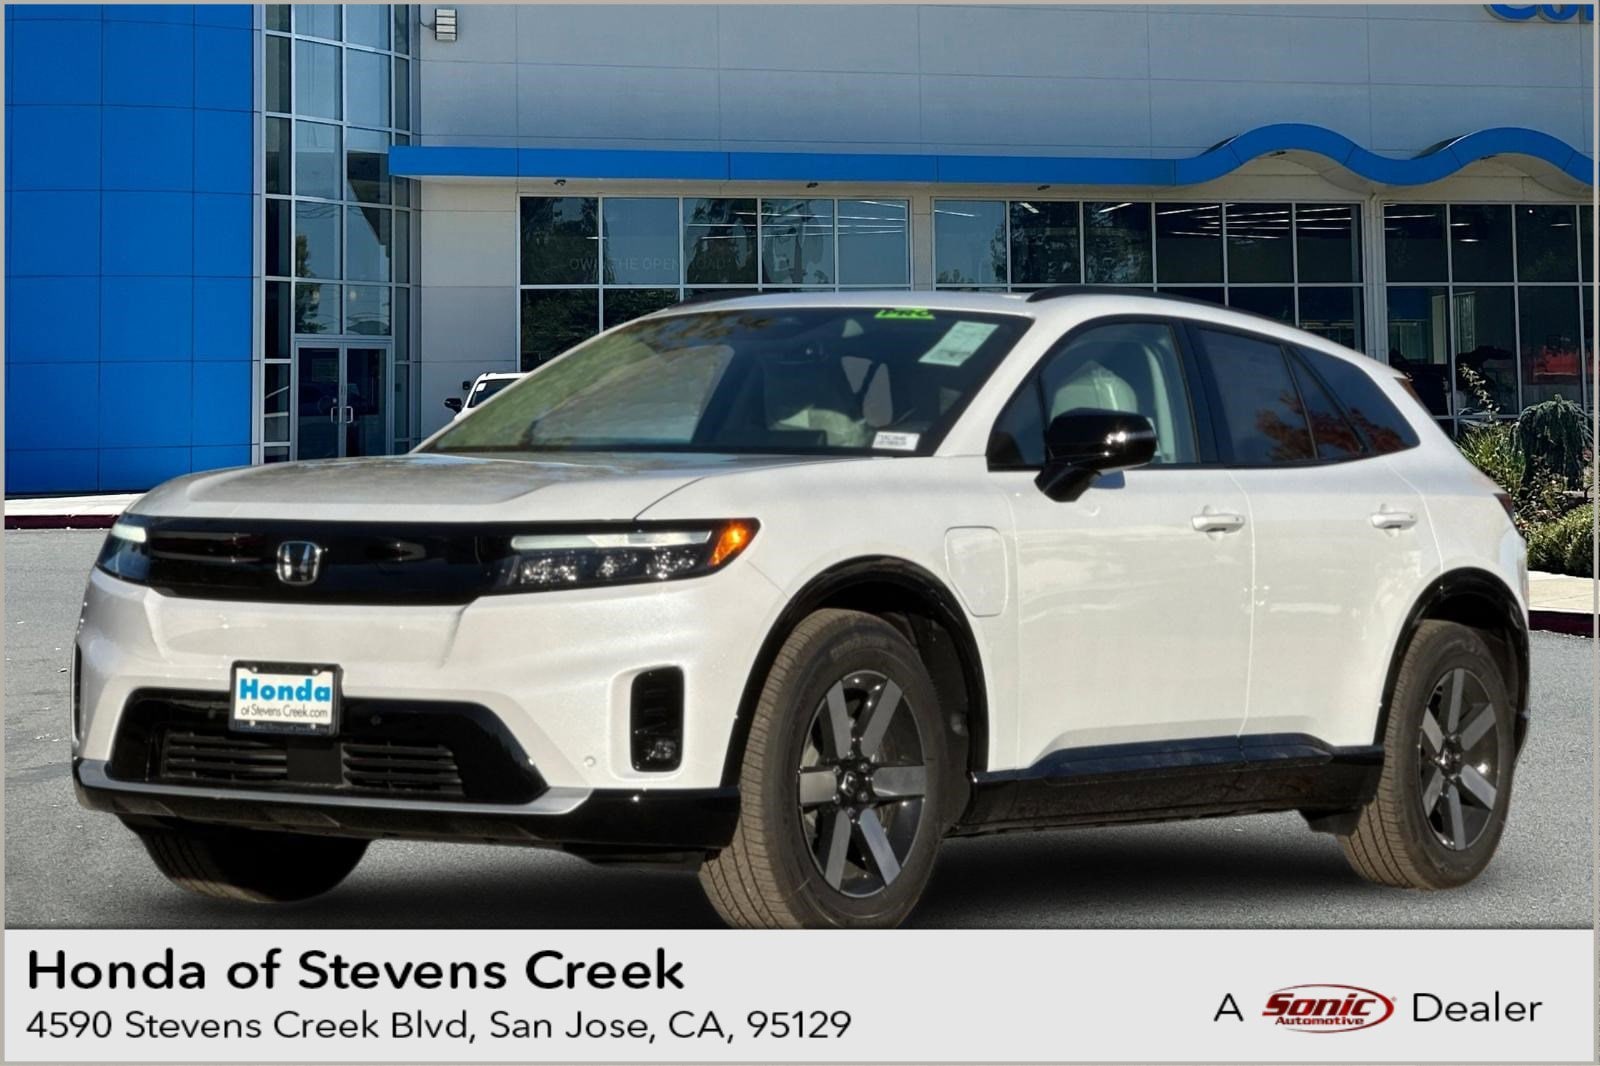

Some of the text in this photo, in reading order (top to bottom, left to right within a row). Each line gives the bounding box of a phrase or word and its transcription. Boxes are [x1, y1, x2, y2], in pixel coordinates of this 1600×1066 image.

[240, 678, 331, 702] Honda
[241, 705, 250, 716] of
[251, 704, 281, 717] Stevens
